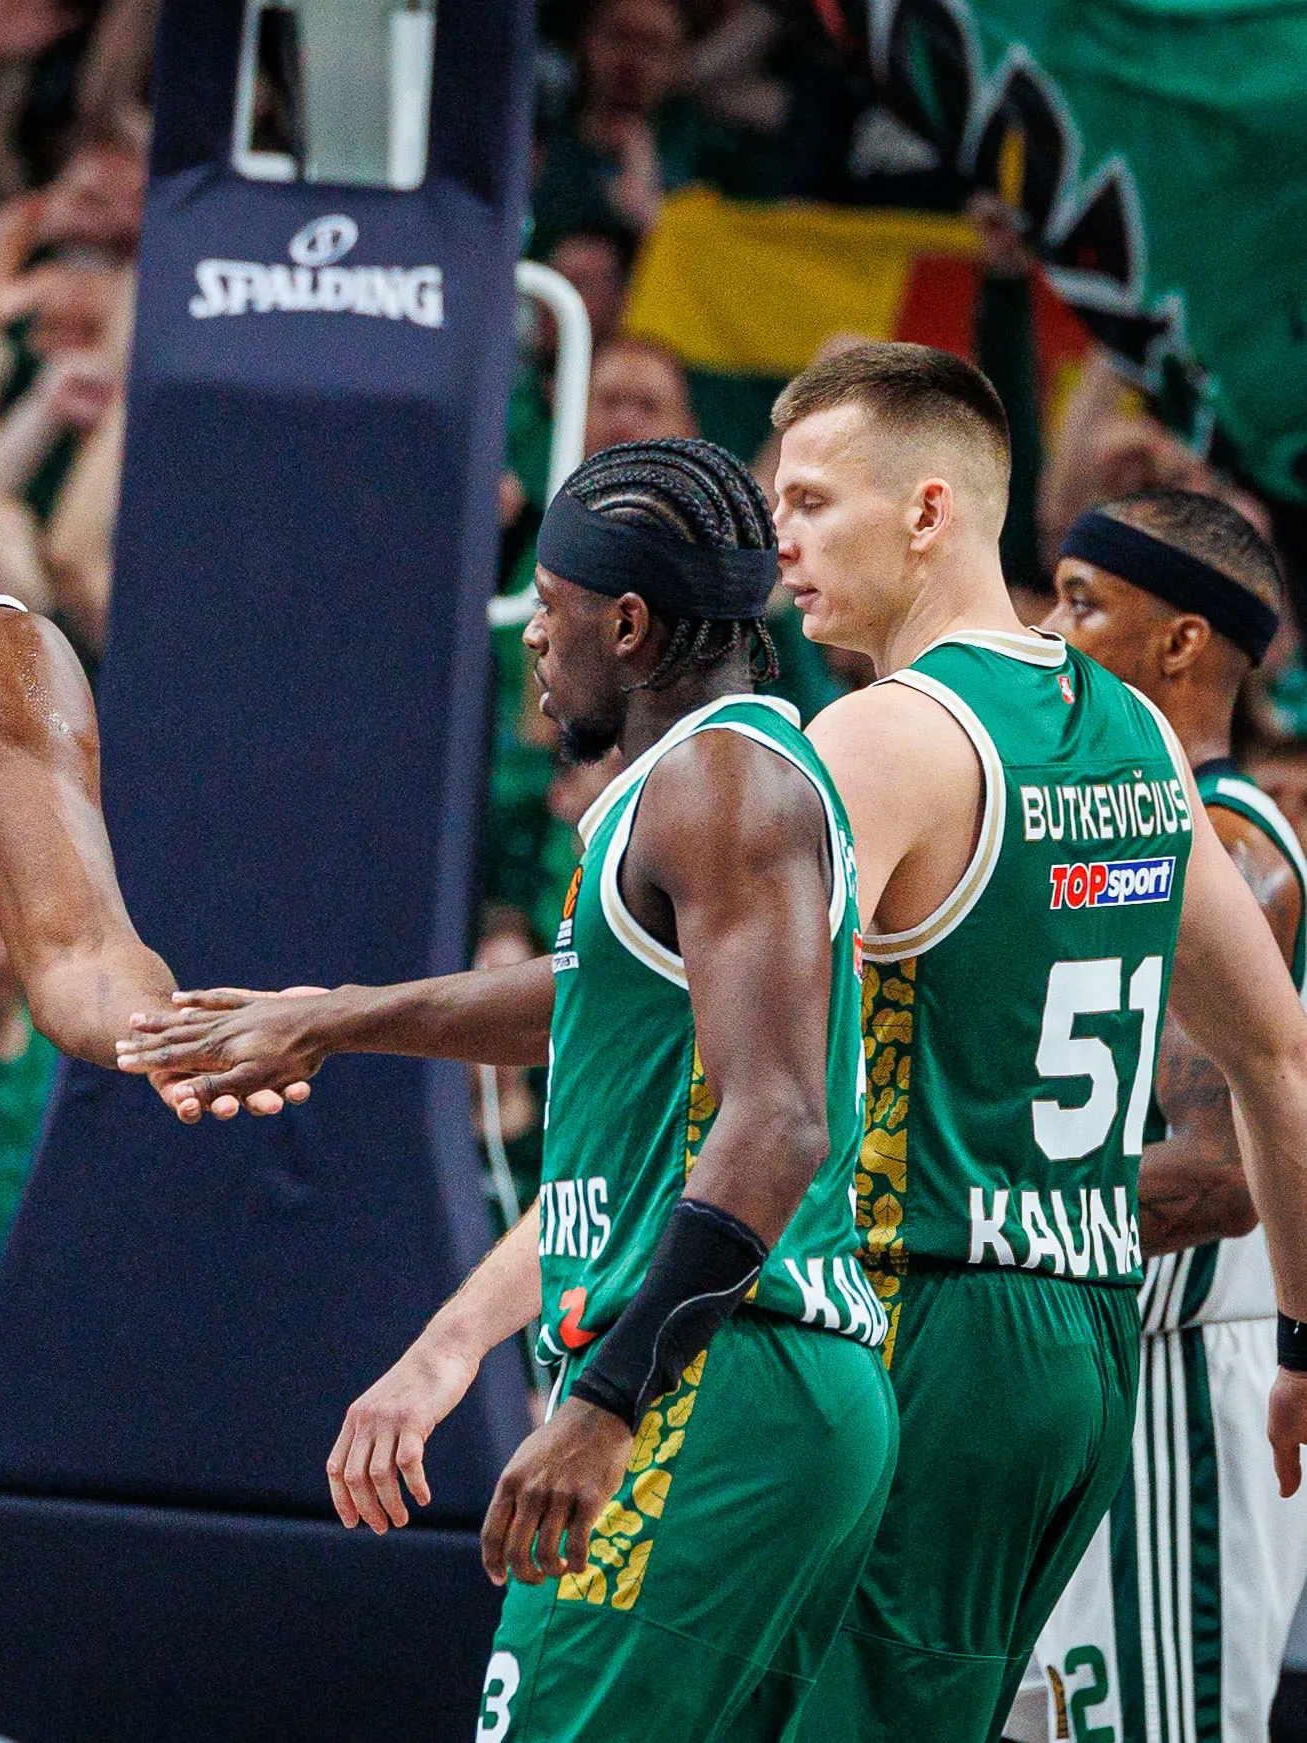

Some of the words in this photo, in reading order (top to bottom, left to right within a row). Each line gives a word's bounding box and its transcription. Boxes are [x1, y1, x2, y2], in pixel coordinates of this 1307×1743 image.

[189, 258, 445, 329] SPALDING
[1020, 769, 1192, 842] BUTKEVIČIUS
[1050, 860, 1173, 910] TOPsport
[1031, 955, 1163, 1161] 51
[968, 1186, 1142, 1277] KAUNA
[476, 1651, 520, 1743] 3
[1064, 1645, 1115, 1743] 2
